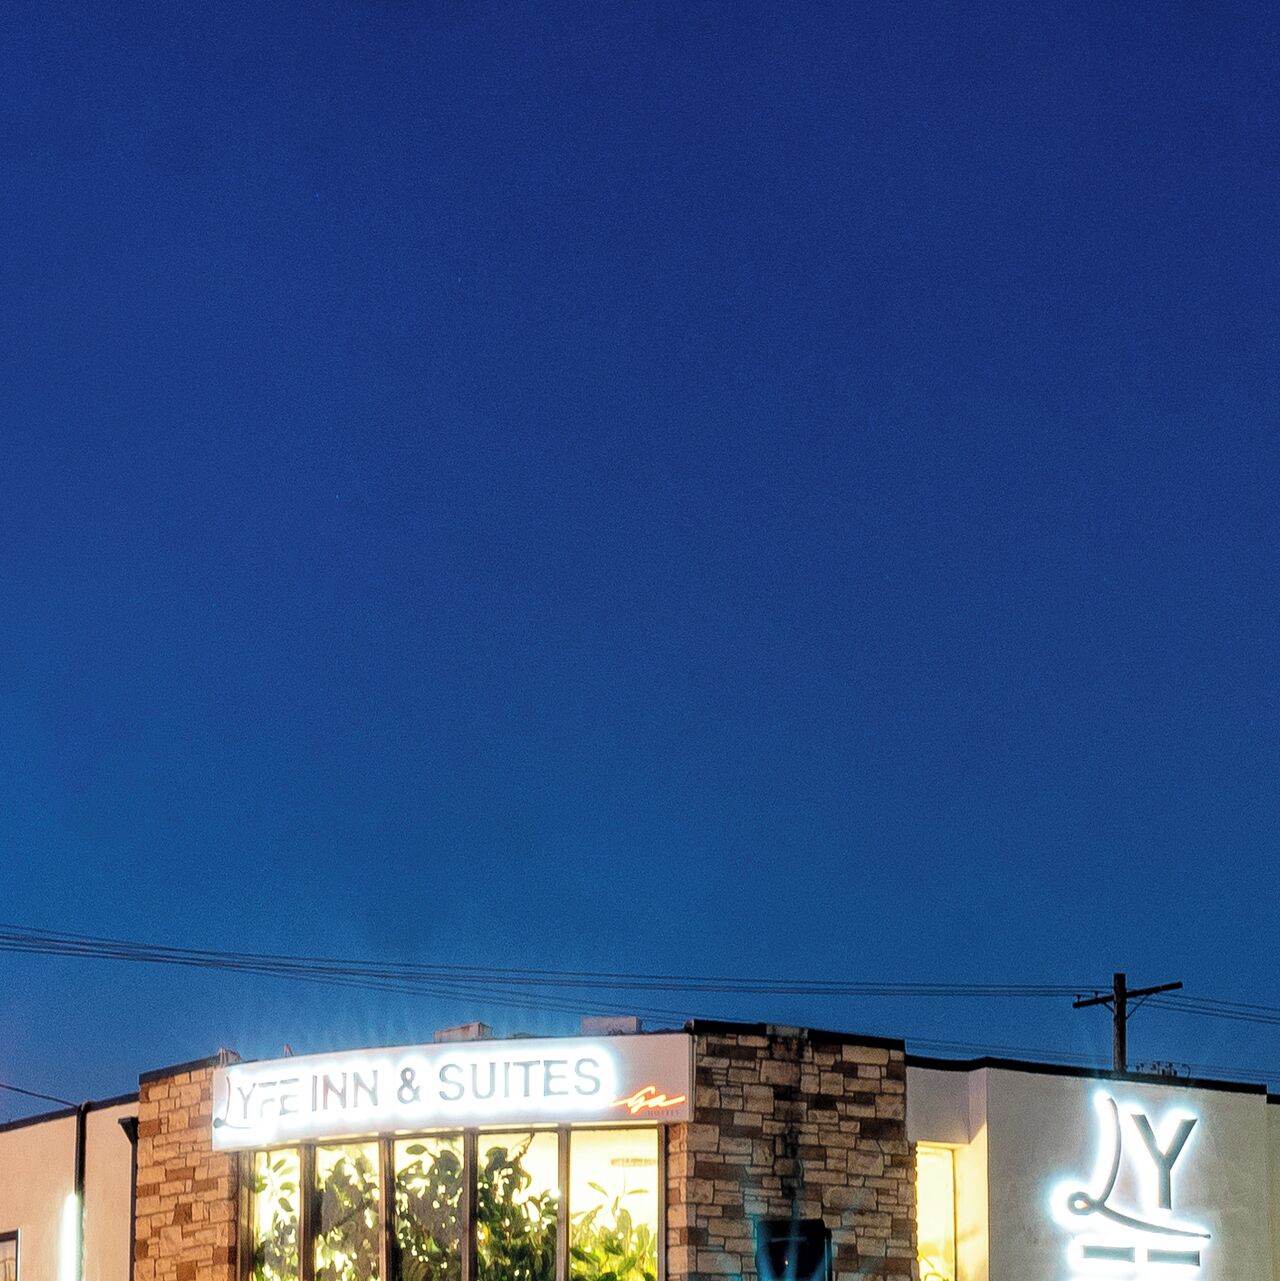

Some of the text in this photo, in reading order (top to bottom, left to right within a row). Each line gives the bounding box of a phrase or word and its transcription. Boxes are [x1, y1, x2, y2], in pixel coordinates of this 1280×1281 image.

[312, 1070, 378, 1111] INN
[397, 1067, 421, 1103] &
[438, 1058, 601, 1101] SUITES
